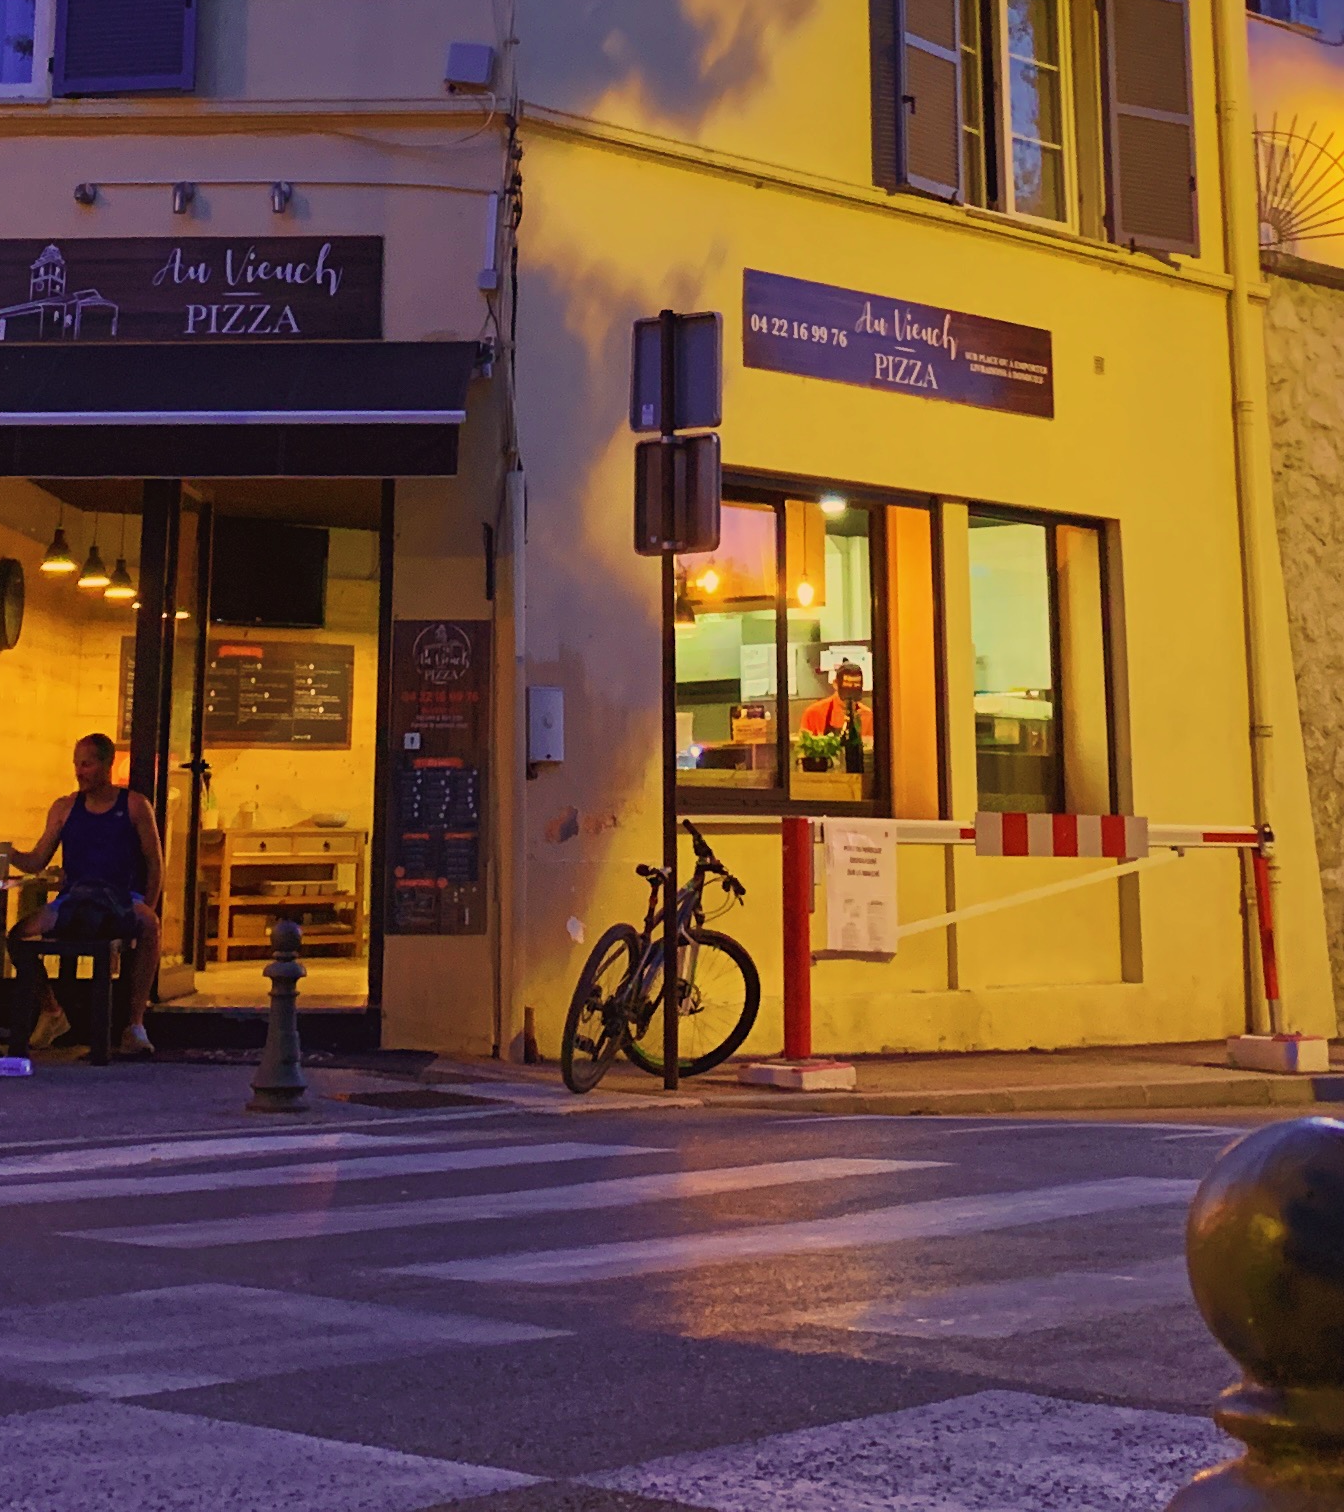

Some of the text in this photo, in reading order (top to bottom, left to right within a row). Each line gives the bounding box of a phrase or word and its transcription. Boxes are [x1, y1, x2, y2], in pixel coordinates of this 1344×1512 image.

[153, 243, 344, 296] Au Vieuch
[184, 304, 302, 334] PIZZA
[751, 313, 848, 348] 04 22 16 99 76
[855, 301, 888, 336] Au
[874, 353, 939, 390] PIZZA
